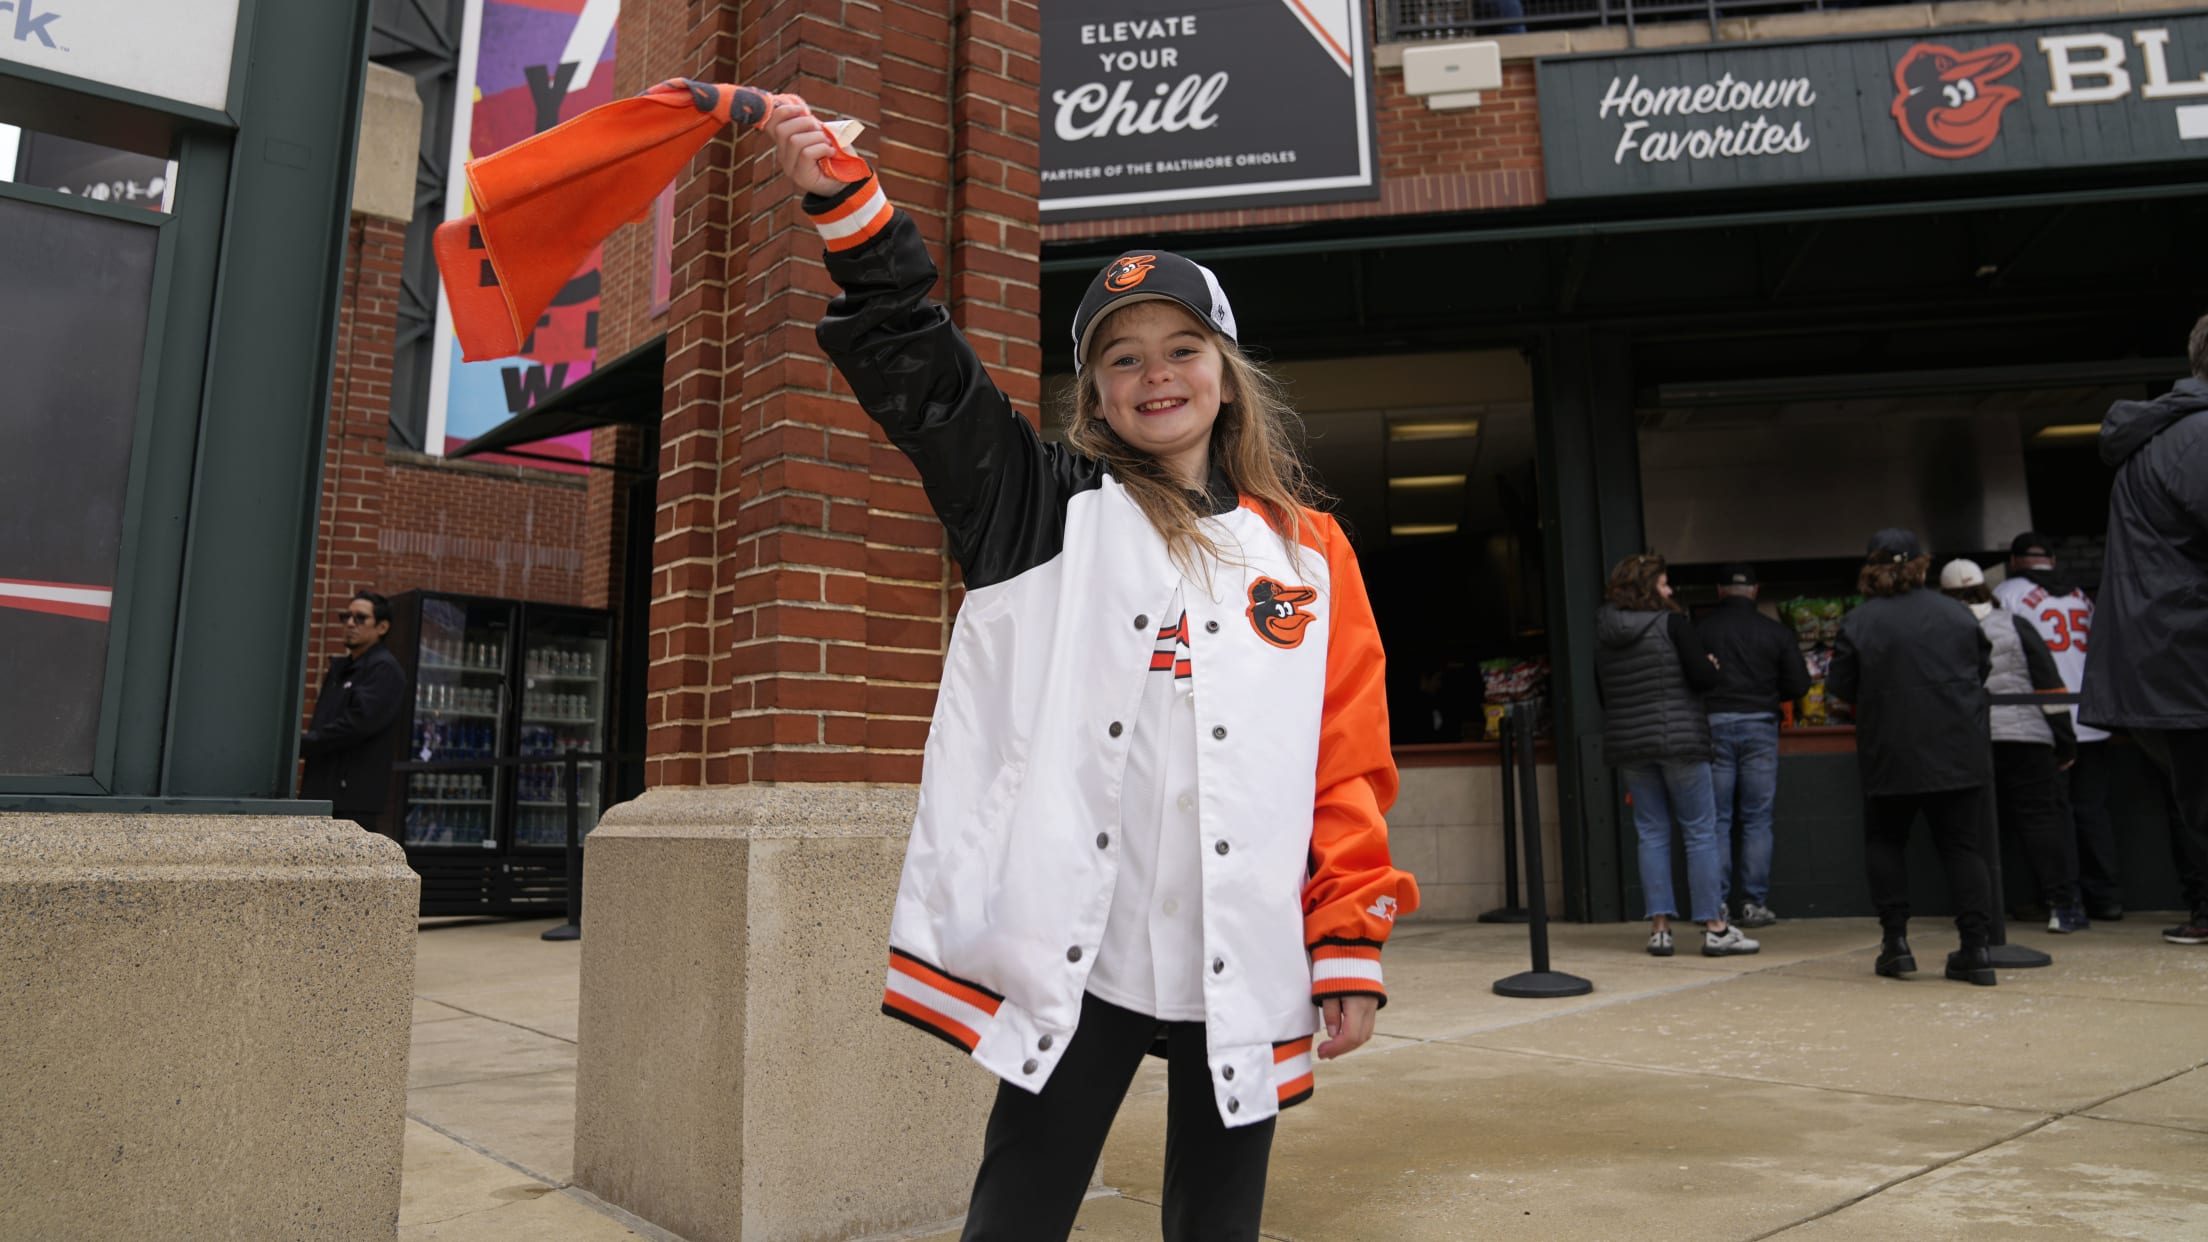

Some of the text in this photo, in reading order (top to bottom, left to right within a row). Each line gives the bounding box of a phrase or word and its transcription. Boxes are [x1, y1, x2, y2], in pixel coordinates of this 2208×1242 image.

[1081, 15, 1197, 44] ELEVATE
[1100, 48, 1178, 72] YOUR
[1052, 71, 1229, 141] Chill
[1600, 72, 1816, 119] Hometown
[1615, 114, 1810, 165] Favorites
[1041, 150, 1296, 182] PARTNER OF THE BALTIMORE ORIOLES
[2040, 608, 2091, 653] 35
